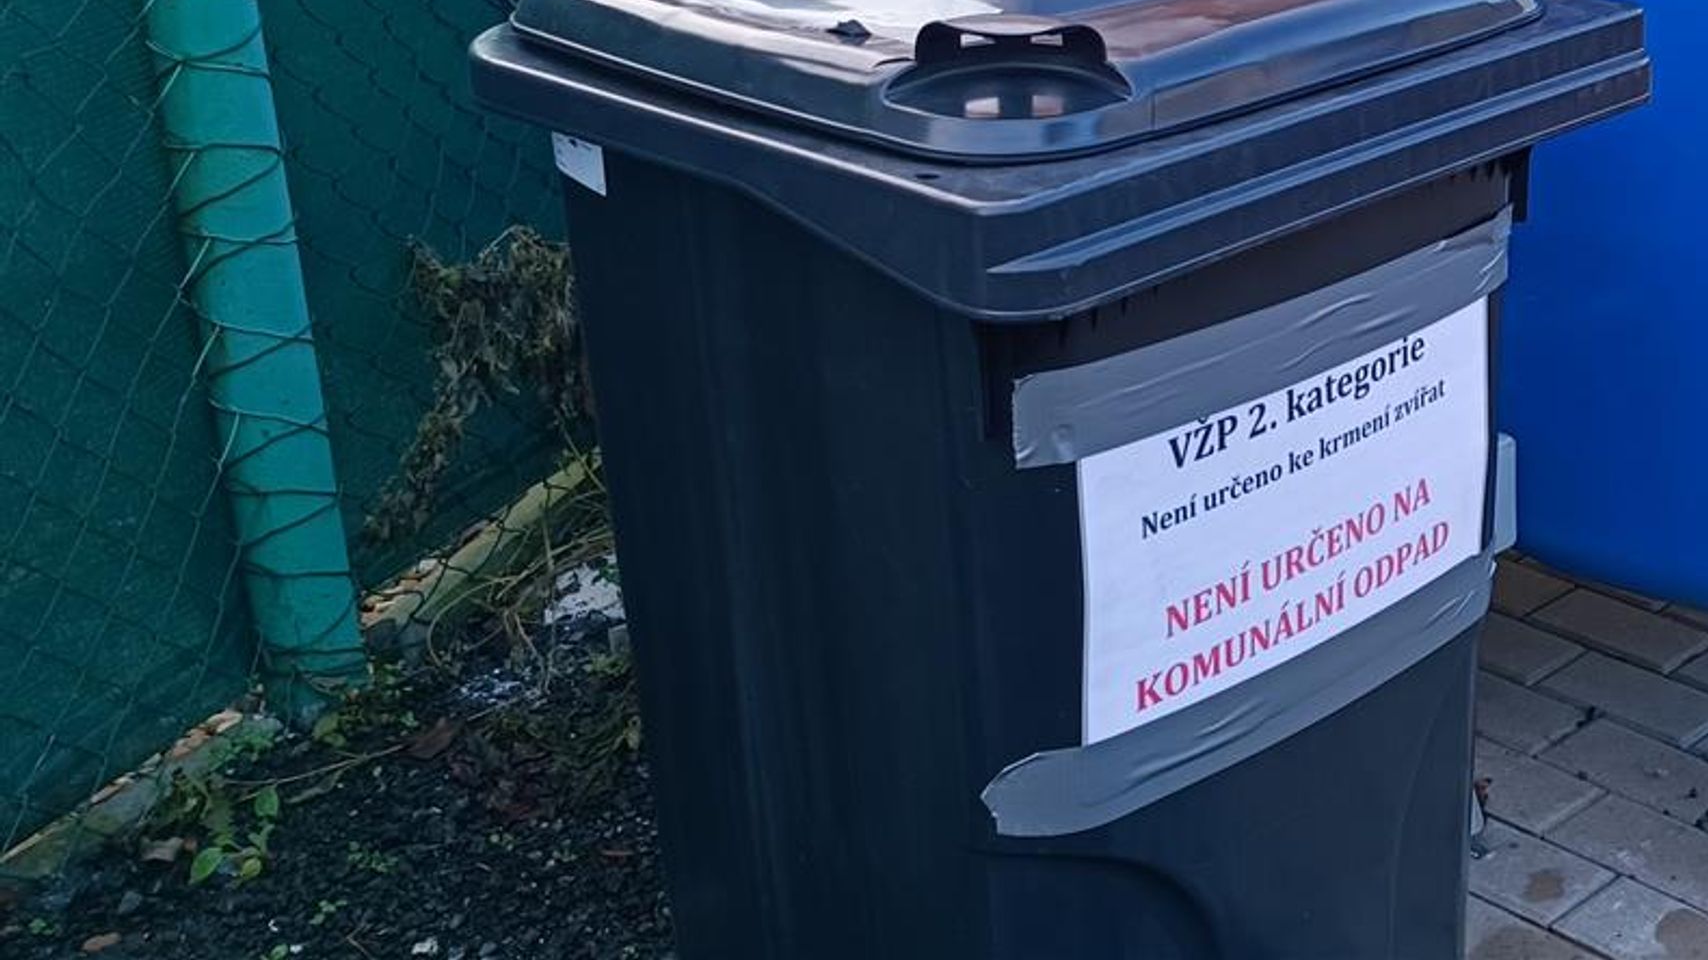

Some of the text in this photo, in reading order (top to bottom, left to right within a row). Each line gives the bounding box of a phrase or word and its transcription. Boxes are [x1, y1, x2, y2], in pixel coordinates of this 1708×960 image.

[1141, 379, 1446, 539] Není určeno ke krmení zvířat
[1168, 335, 1426, 470] VŽP 2. kategorie
[1135, 520, 1451, 713] KOMUNÁLNÍ ODPAD
[1165, 476, 1432, 638] NENÍ URČENO NA
